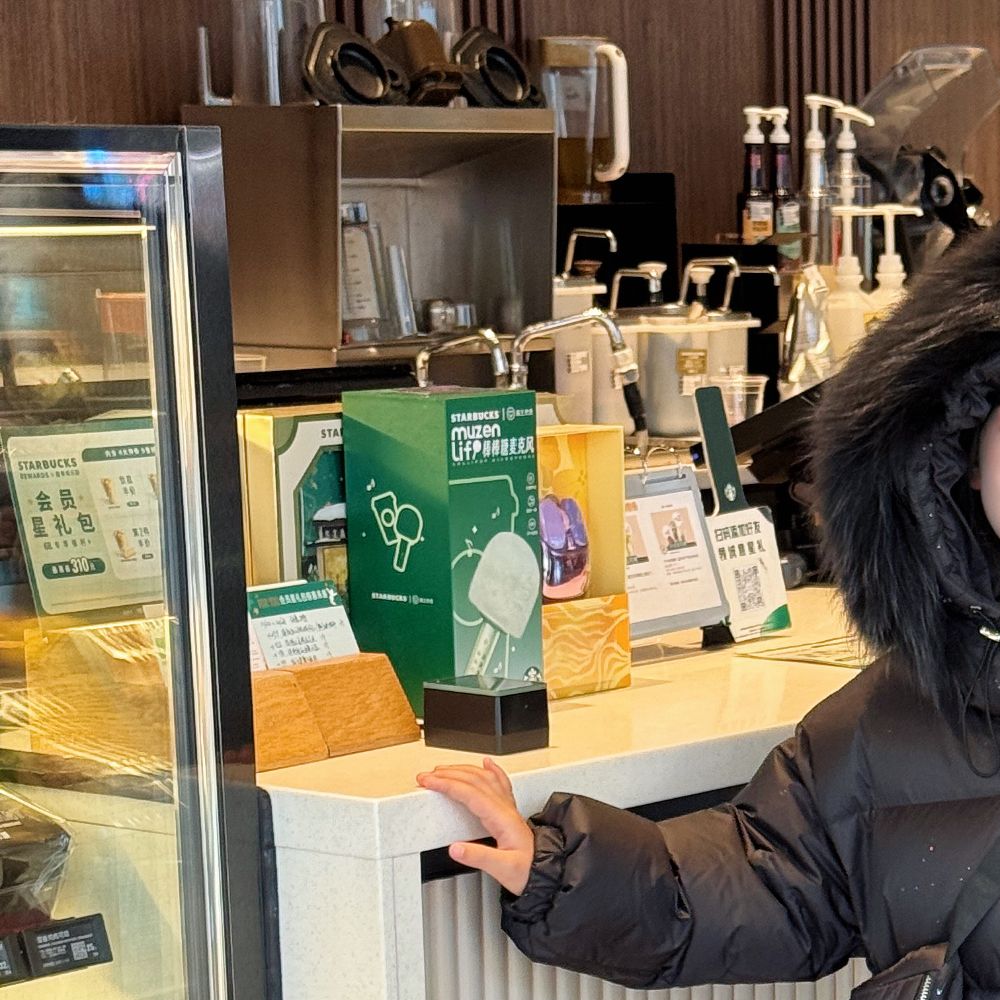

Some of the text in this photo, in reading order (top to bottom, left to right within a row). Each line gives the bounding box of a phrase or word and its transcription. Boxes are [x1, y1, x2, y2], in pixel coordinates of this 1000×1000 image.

[451, 410, 500, 423] STARBUCKS
[451, 423, 501, 441] muzen
[18, 457, 78, 471] STARBUCKS
[35, 489, 77, 512] 会员
[31, 512, 96, 538] 星礼包
